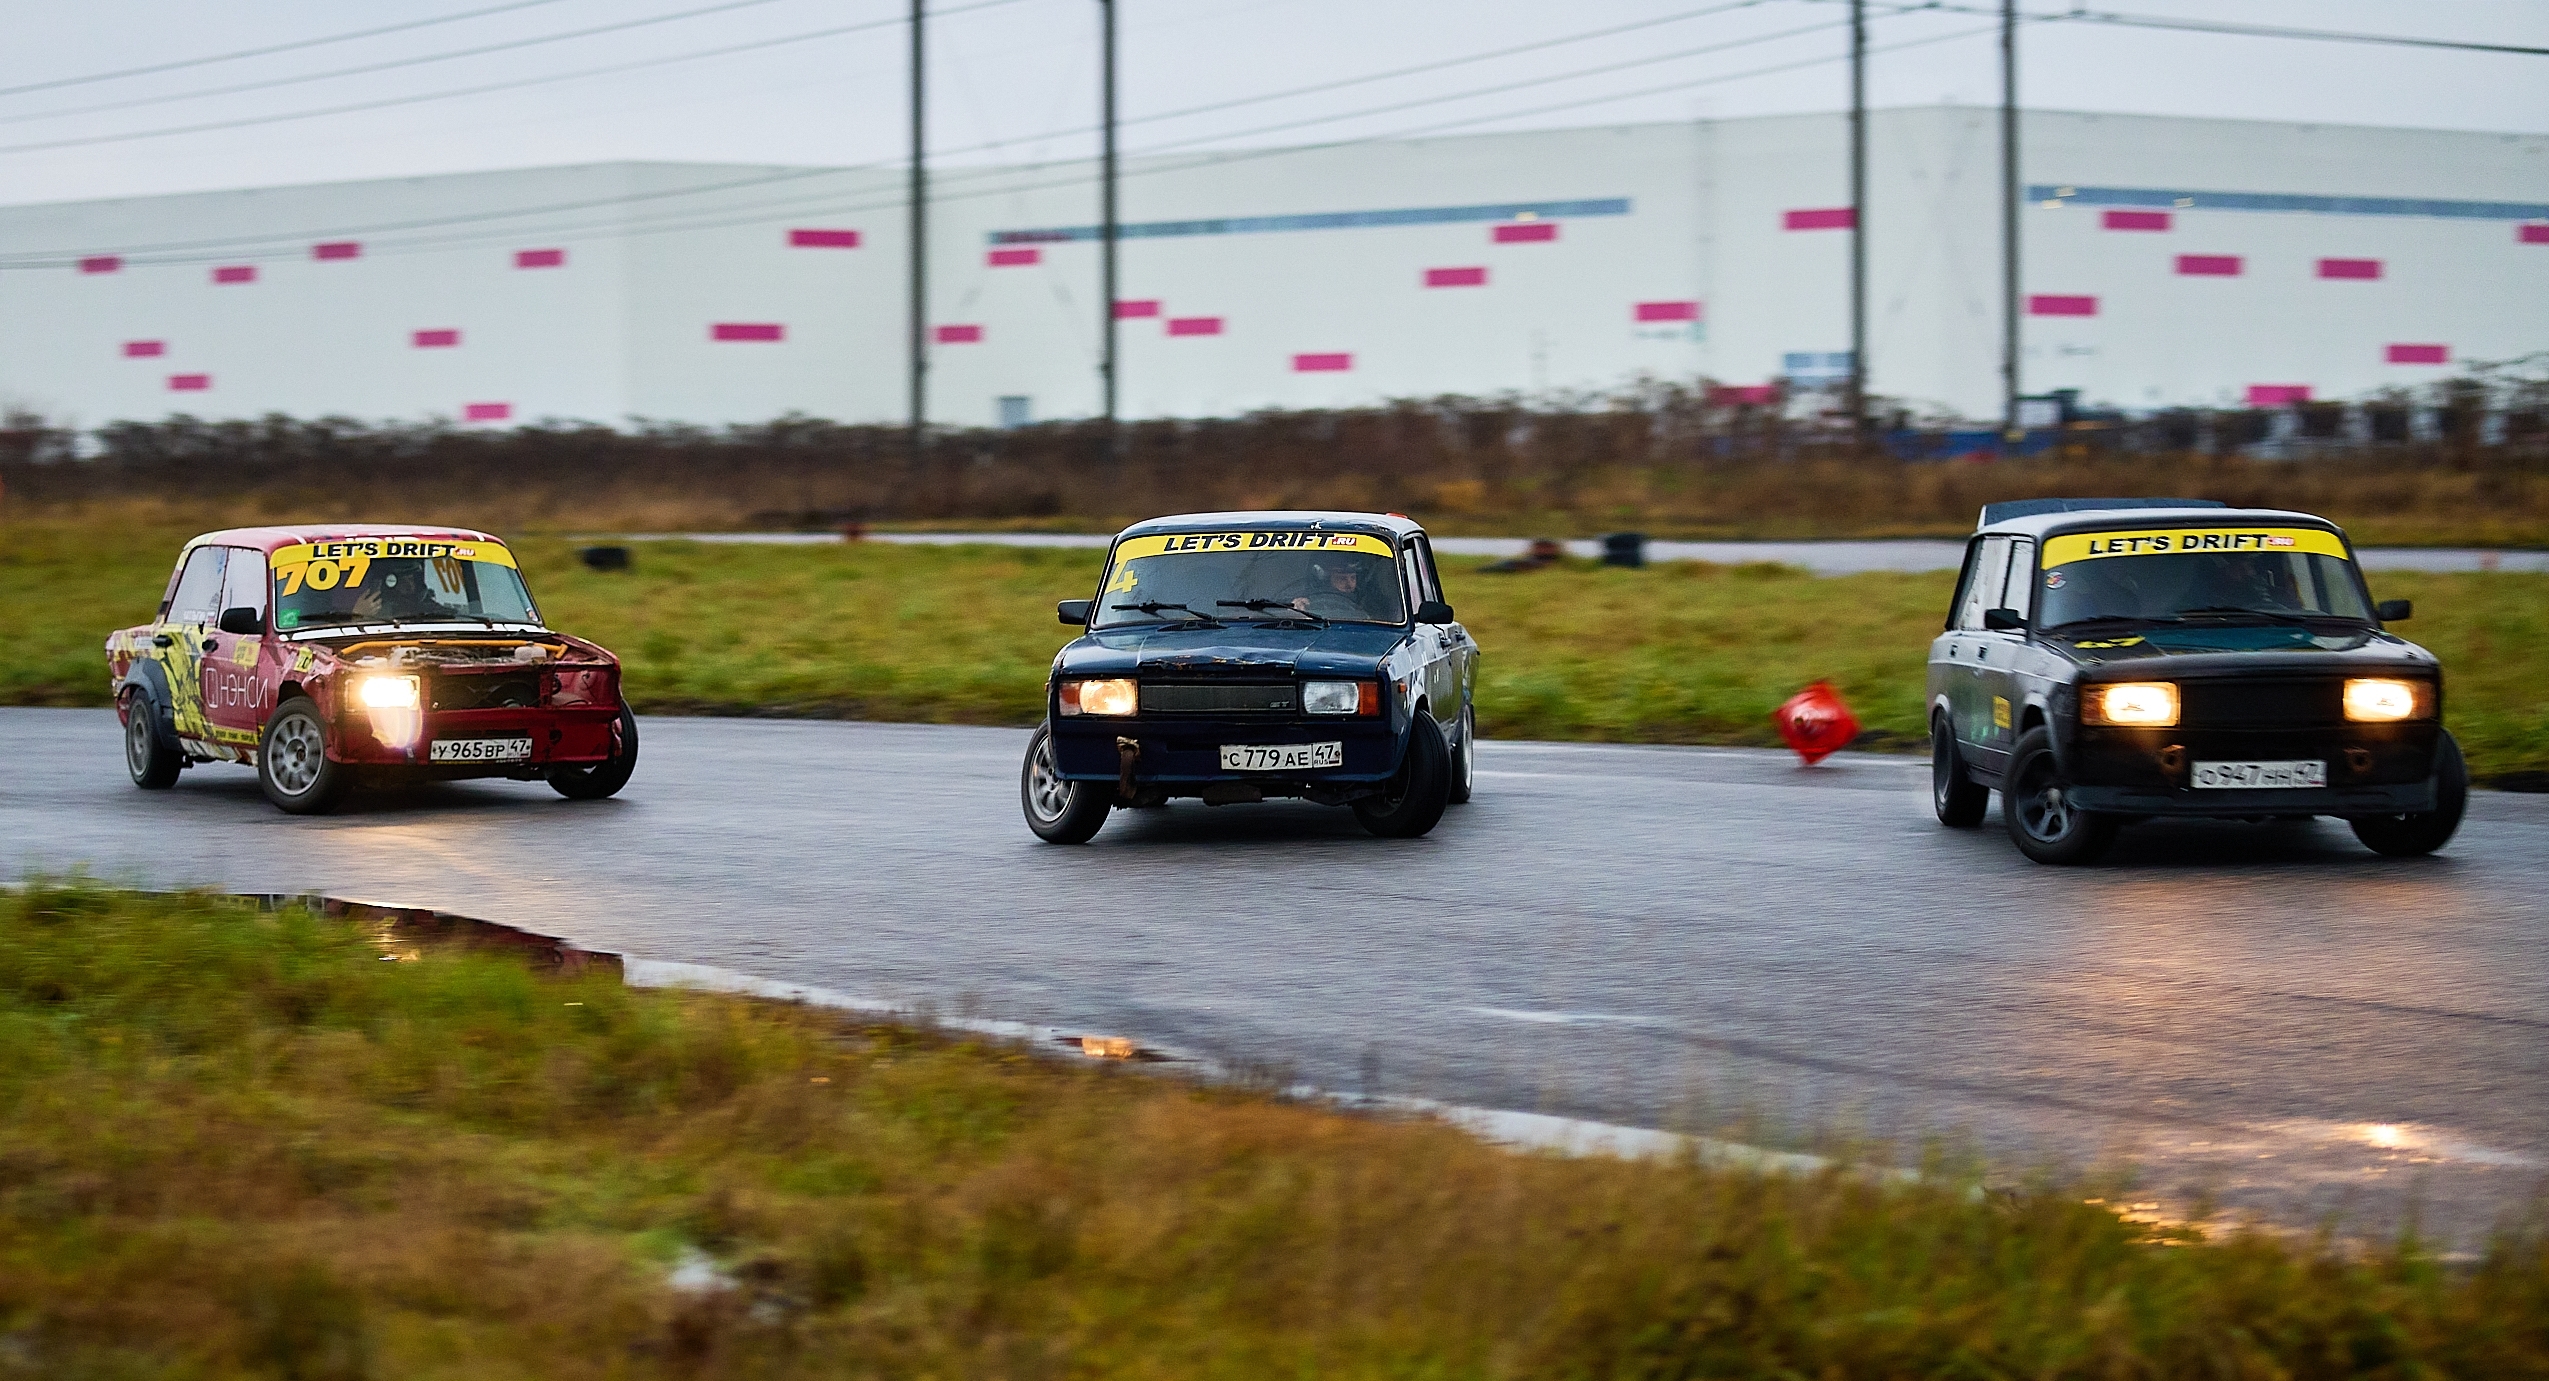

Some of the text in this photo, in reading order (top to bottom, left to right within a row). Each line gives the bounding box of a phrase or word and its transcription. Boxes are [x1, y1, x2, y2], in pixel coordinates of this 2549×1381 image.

[313, 543, 378, 558] LET'S
[1164, 534, 1241, 552] LET'S
[2089, 535, 2170, 554] LET'S
[276, 557, 371, 597] 707
[220, 673, 269, 709] НЭНСИ
[511, 740, 527, 753] 47
[1315, 745, 1334, 760] 47
